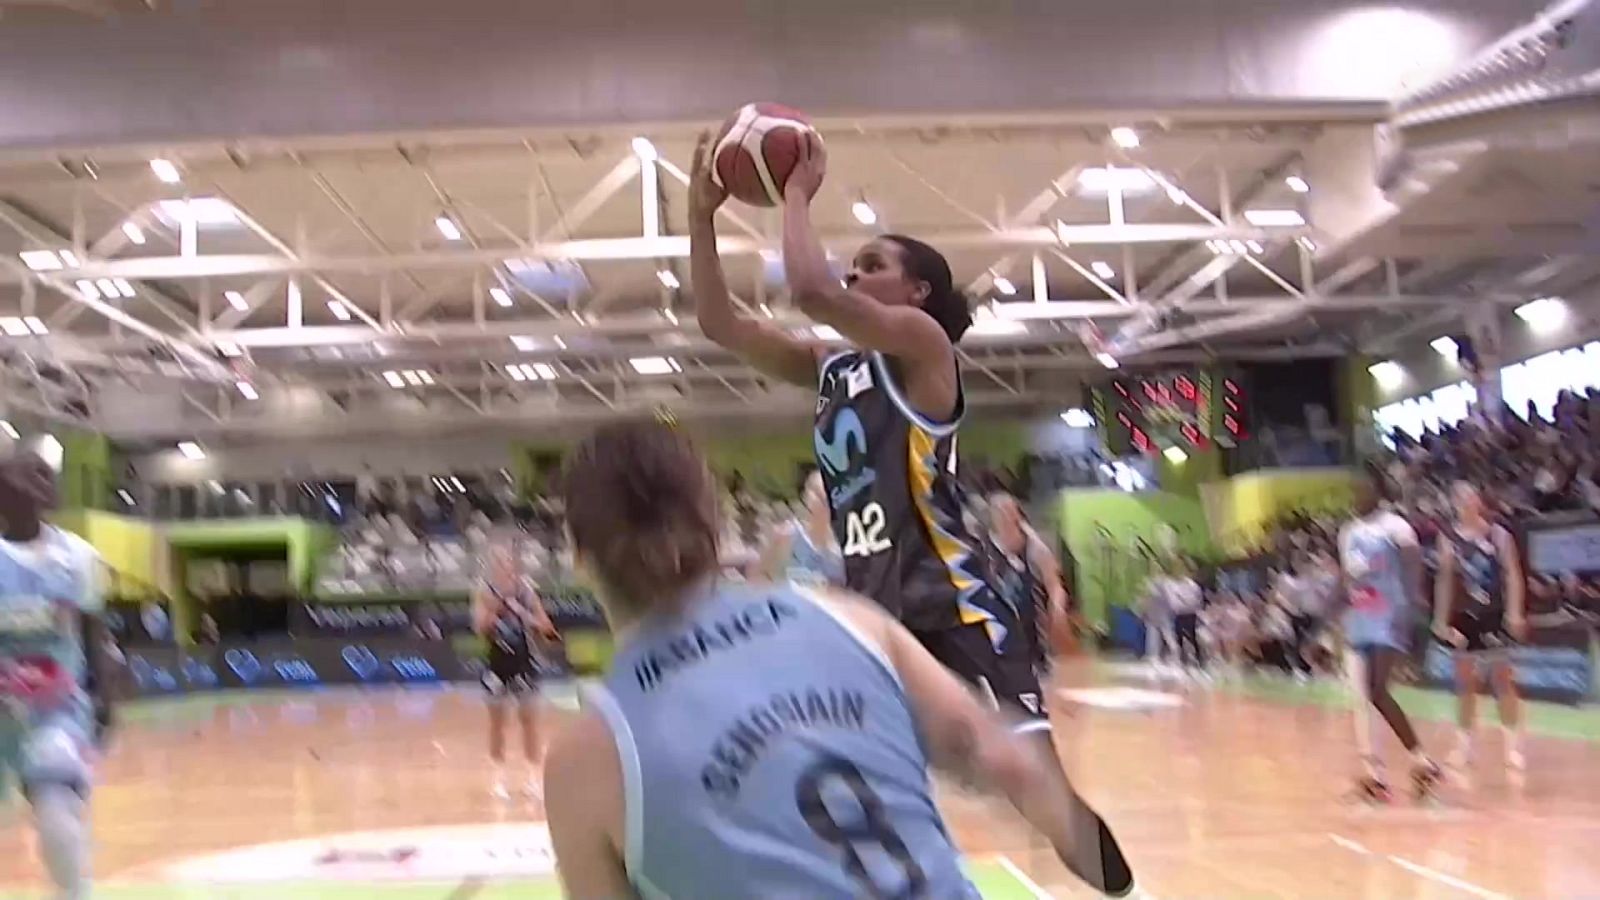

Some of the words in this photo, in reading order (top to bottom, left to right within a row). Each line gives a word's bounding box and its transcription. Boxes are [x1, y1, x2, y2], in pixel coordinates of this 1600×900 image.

[844, 501, 893, 556] 42
[648, 598, 799, 684] ABANCA
[795, 753, 928, 900] 8
